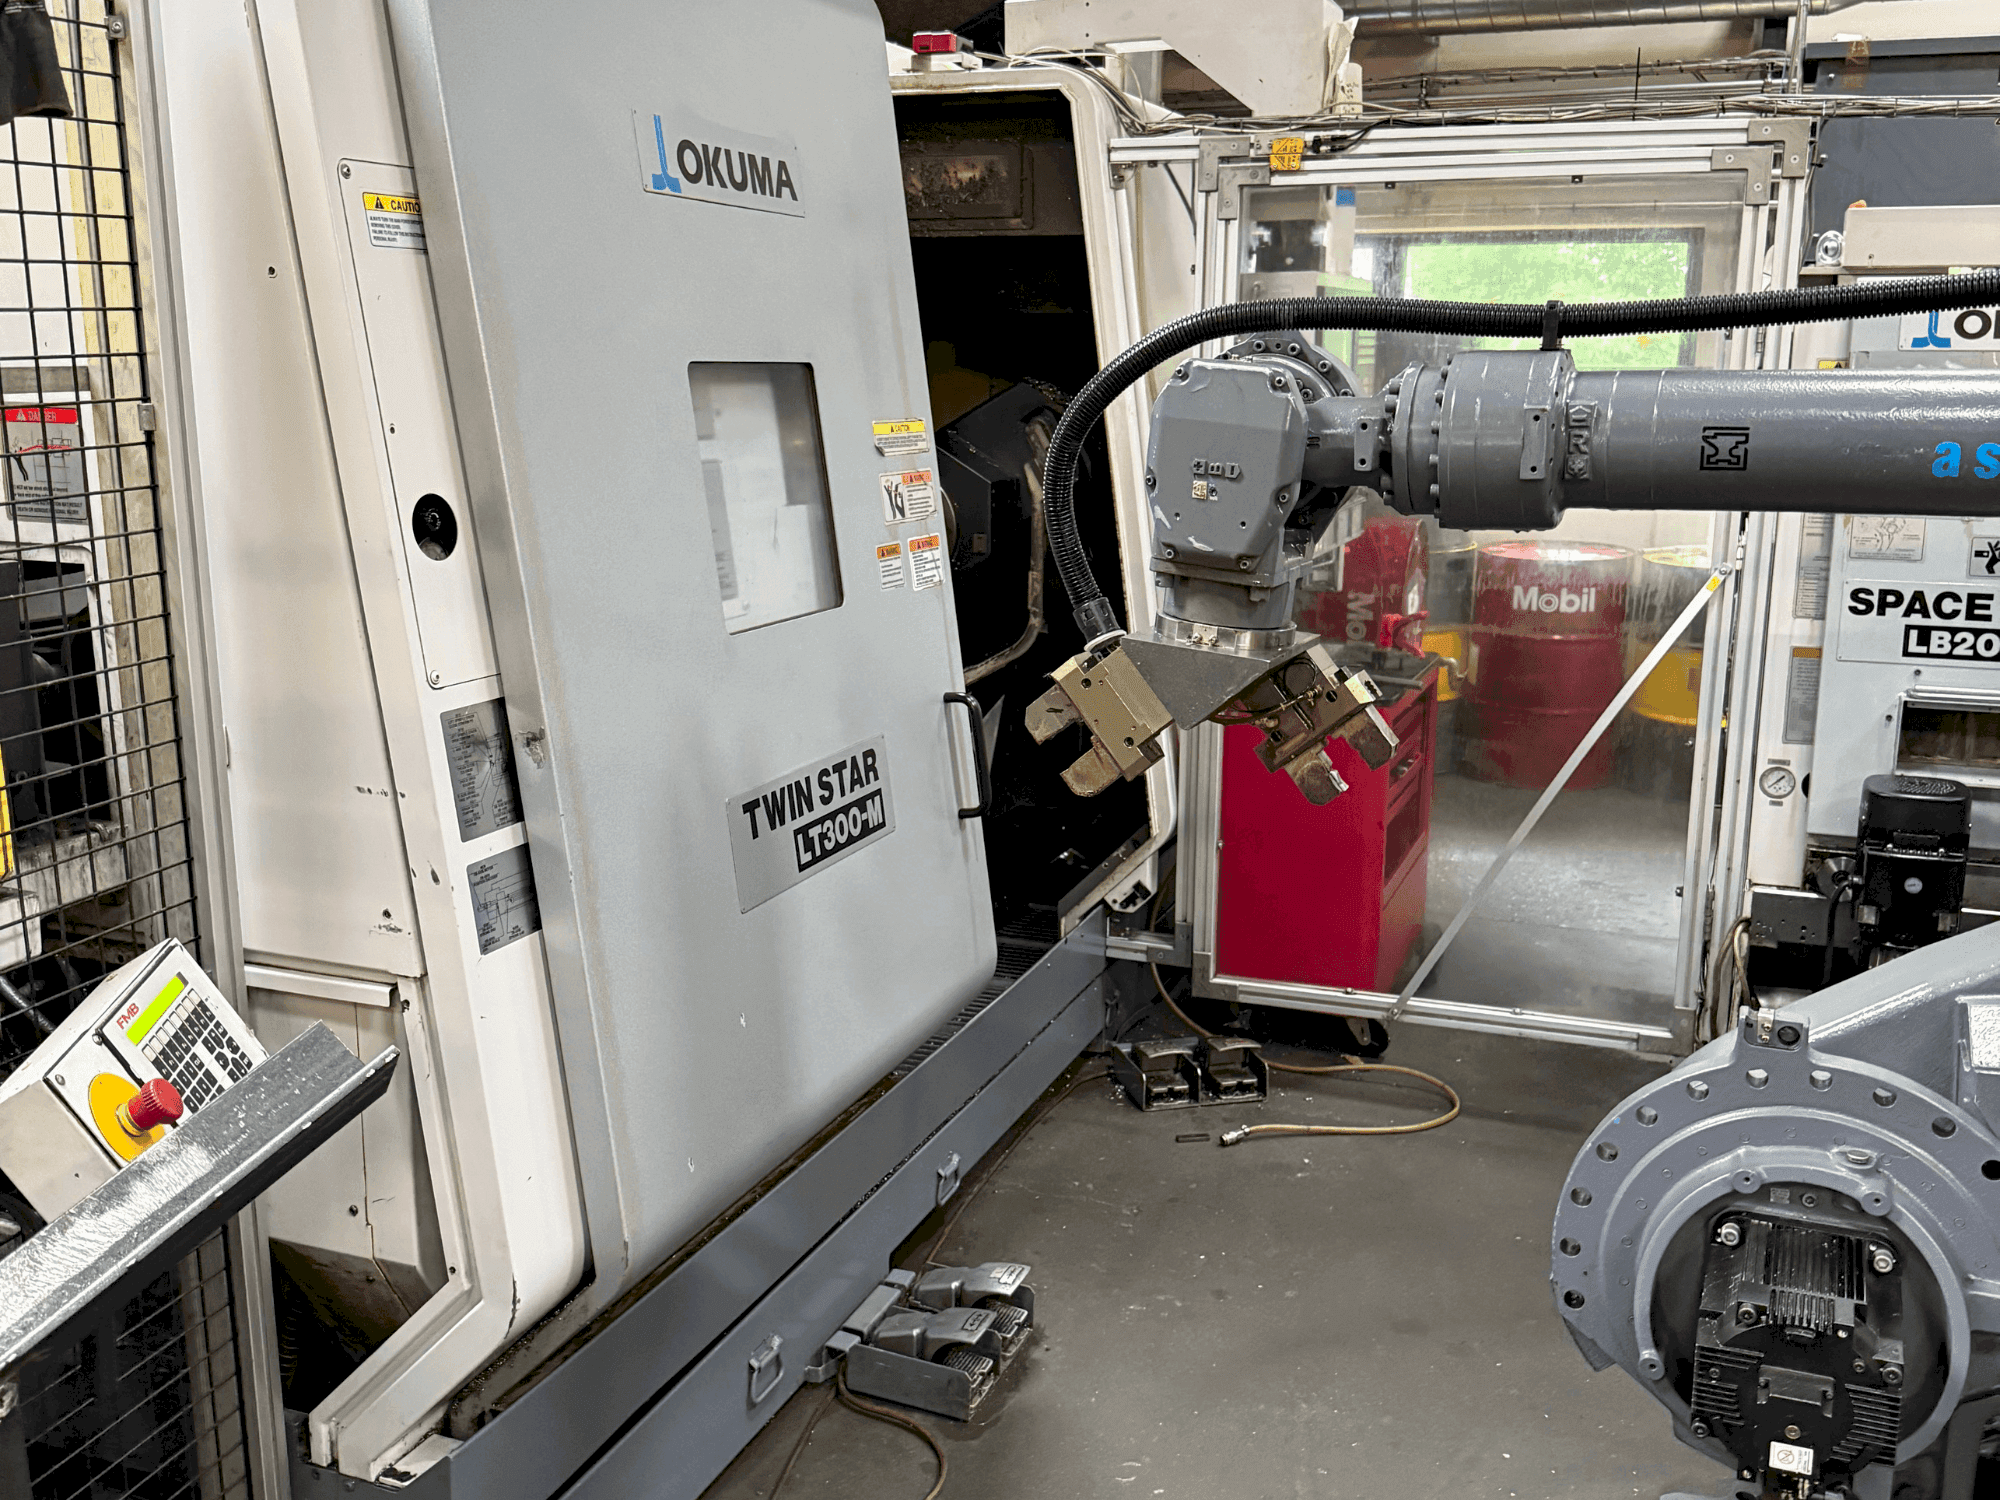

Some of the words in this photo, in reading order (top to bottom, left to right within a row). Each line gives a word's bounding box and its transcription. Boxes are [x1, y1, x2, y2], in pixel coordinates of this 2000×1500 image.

[677, 139, 799, 201] OKUMA
[390, 199, 422, 213] CAUTIO
[1953, 309, 2000, 340] O
[1512, 584, 1596, 614] Mobil
[1848, 587, 1994, 622] SPACE
[1907, 628, 2000, 658] LB20
[741, 775, 815, 840] TWIN
[817, 747, 880, 806] STAR
[796, 794, 884, 866] LT300-M
[116, 1002, 140, 1030] FMB
